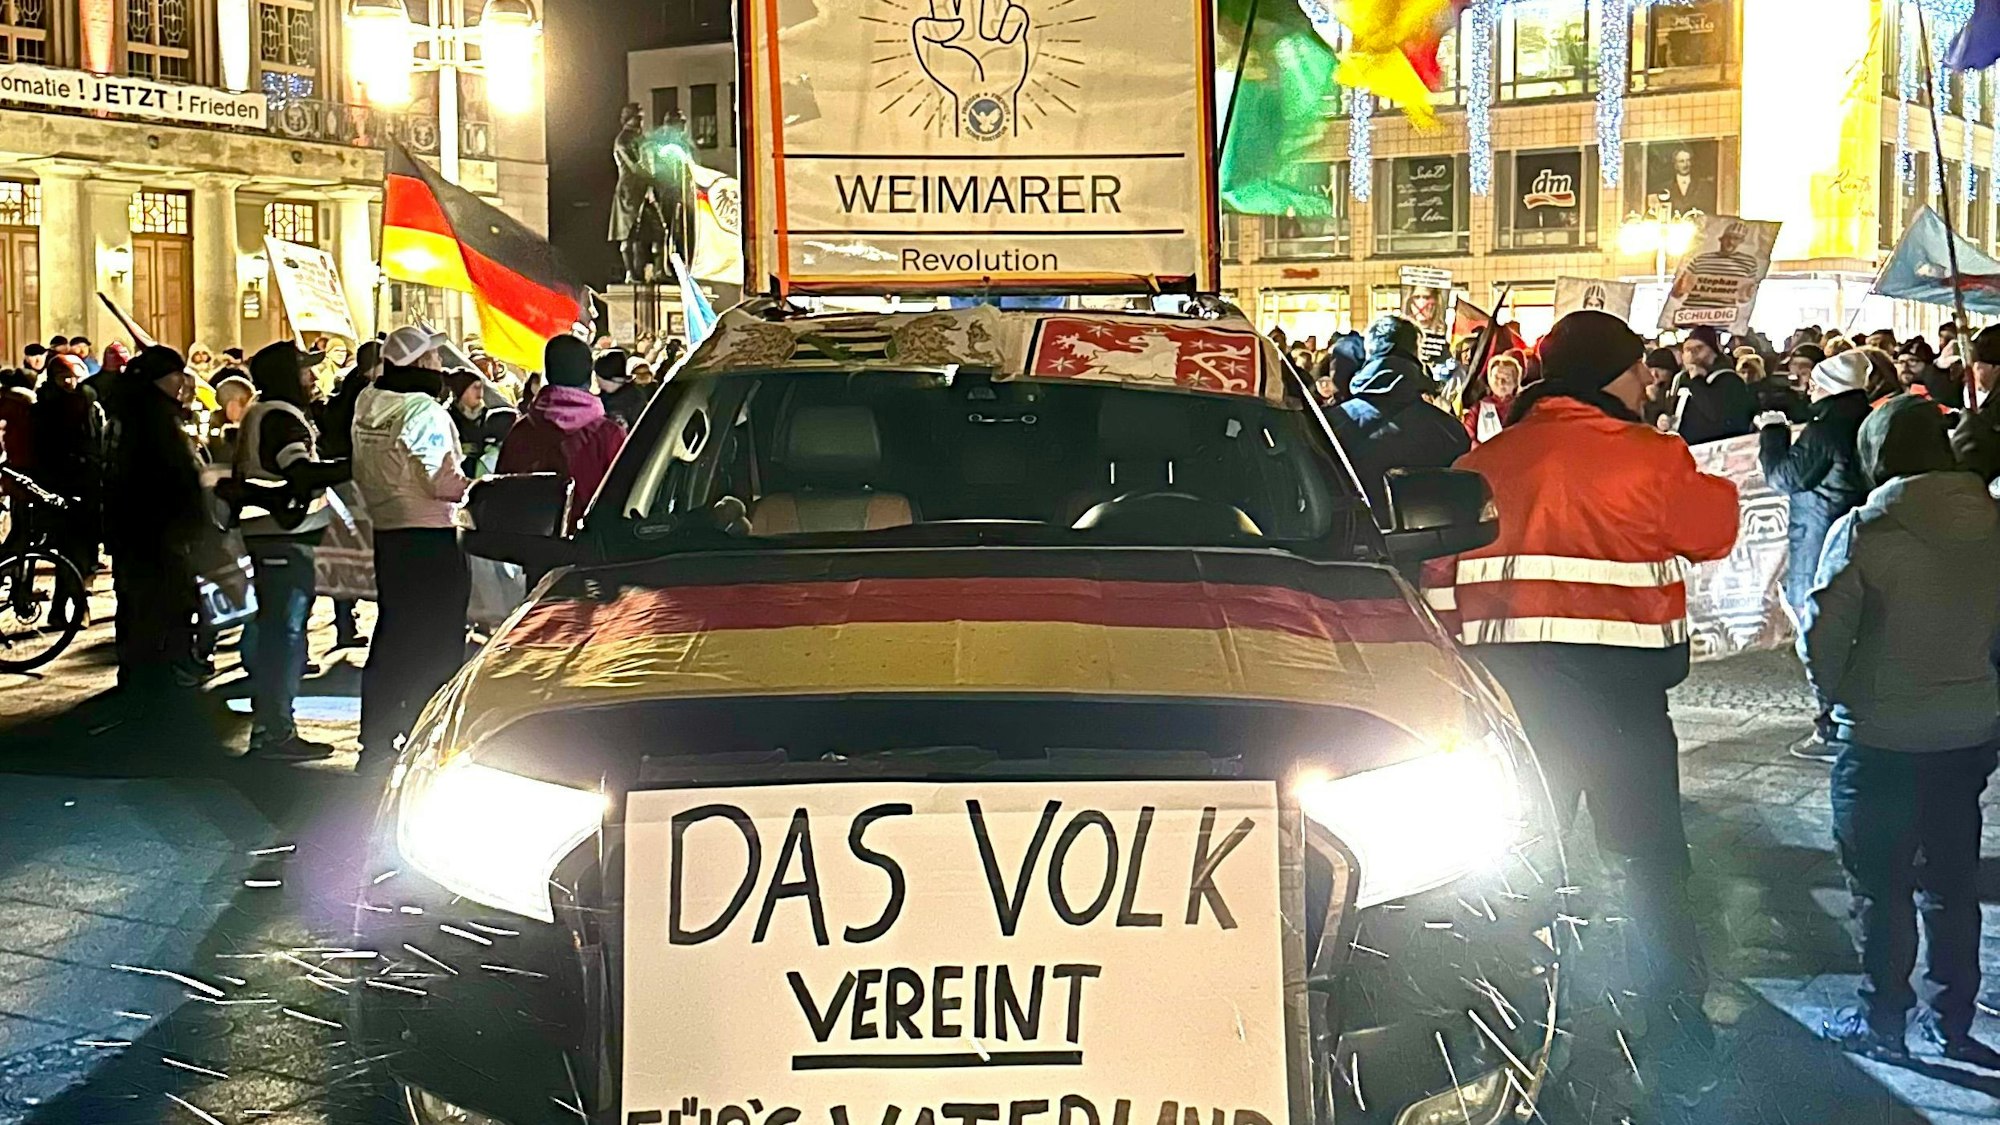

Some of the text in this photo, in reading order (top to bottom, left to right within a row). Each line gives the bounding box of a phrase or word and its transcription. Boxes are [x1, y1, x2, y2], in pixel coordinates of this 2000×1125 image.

[1, 76, 259, 120] omatie ! JETZT ! Frieden
[835, 174, 1122, 214] WEIMARER
[1533, 170, 1571, 193] dm
[902, 249, 1058, 271] Revolution
[1697, 276, 1738, 287] Stephan
[1677, 310, 1734, 322] SCHULDIG
[669, 799, 1256, 946] DAS VOLK
[786, 964, 1102, 1044] VEREINT
